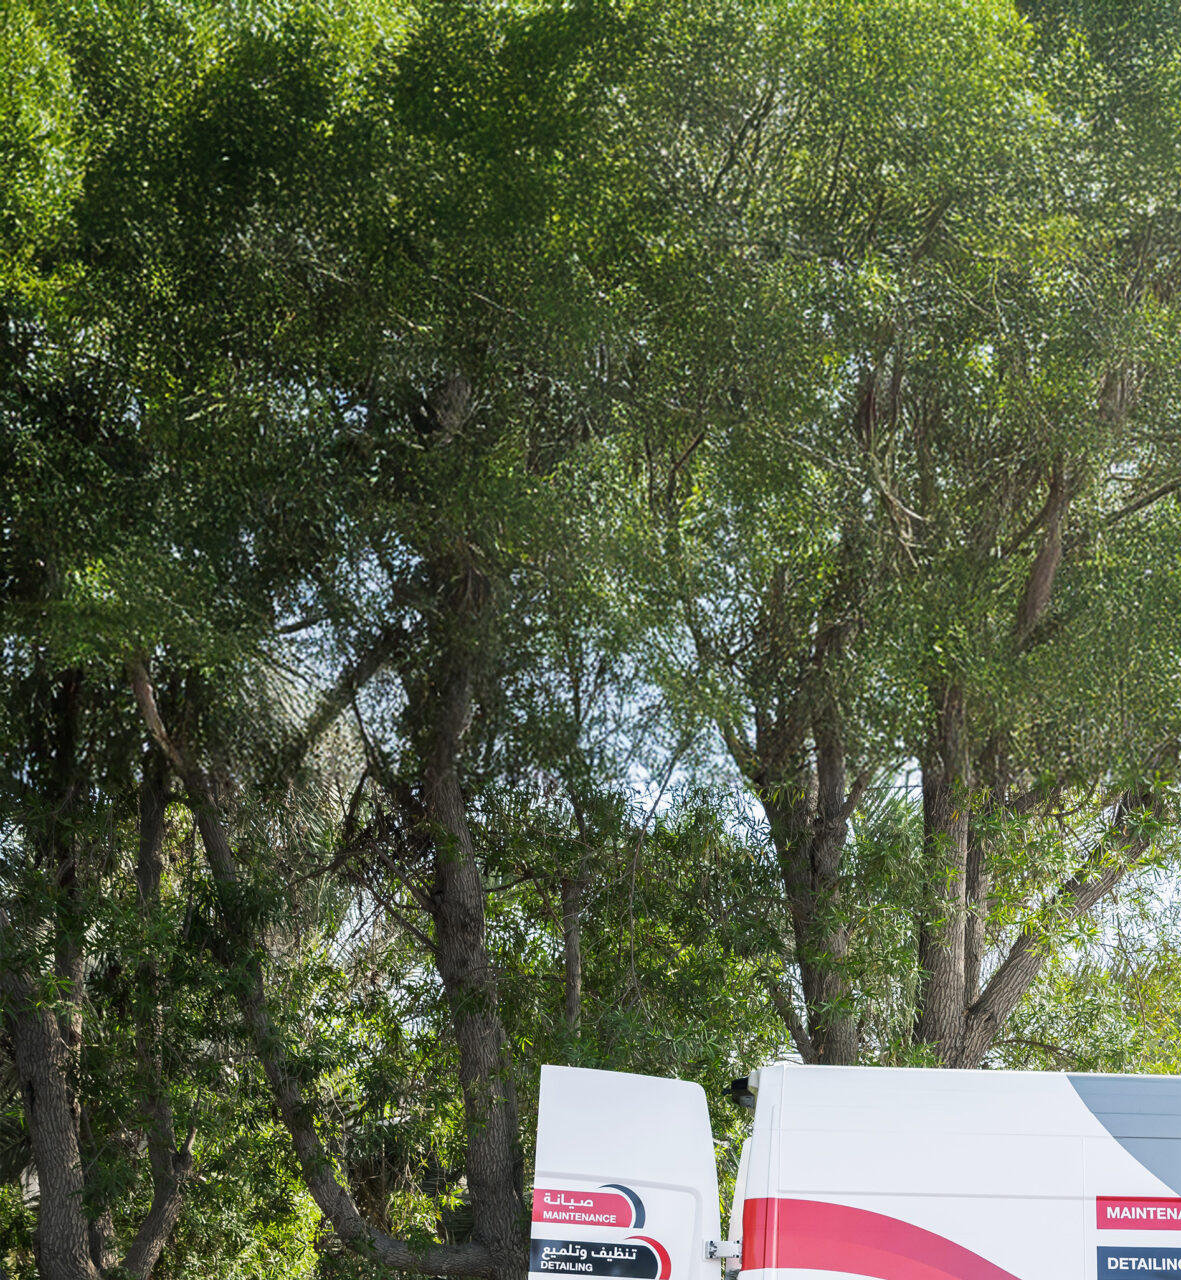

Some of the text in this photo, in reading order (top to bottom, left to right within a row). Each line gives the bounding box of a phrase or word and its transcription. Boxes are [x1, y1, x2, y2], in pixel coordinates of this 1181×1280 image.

[543, 1192, 594, 1209] صيانة
[543, 1210, 617, 1224] MAINTENANCE
[541, 1243, 638, 1262] تنظيف وتلميع
[540, 1261, 593, 1272] DETAILING
